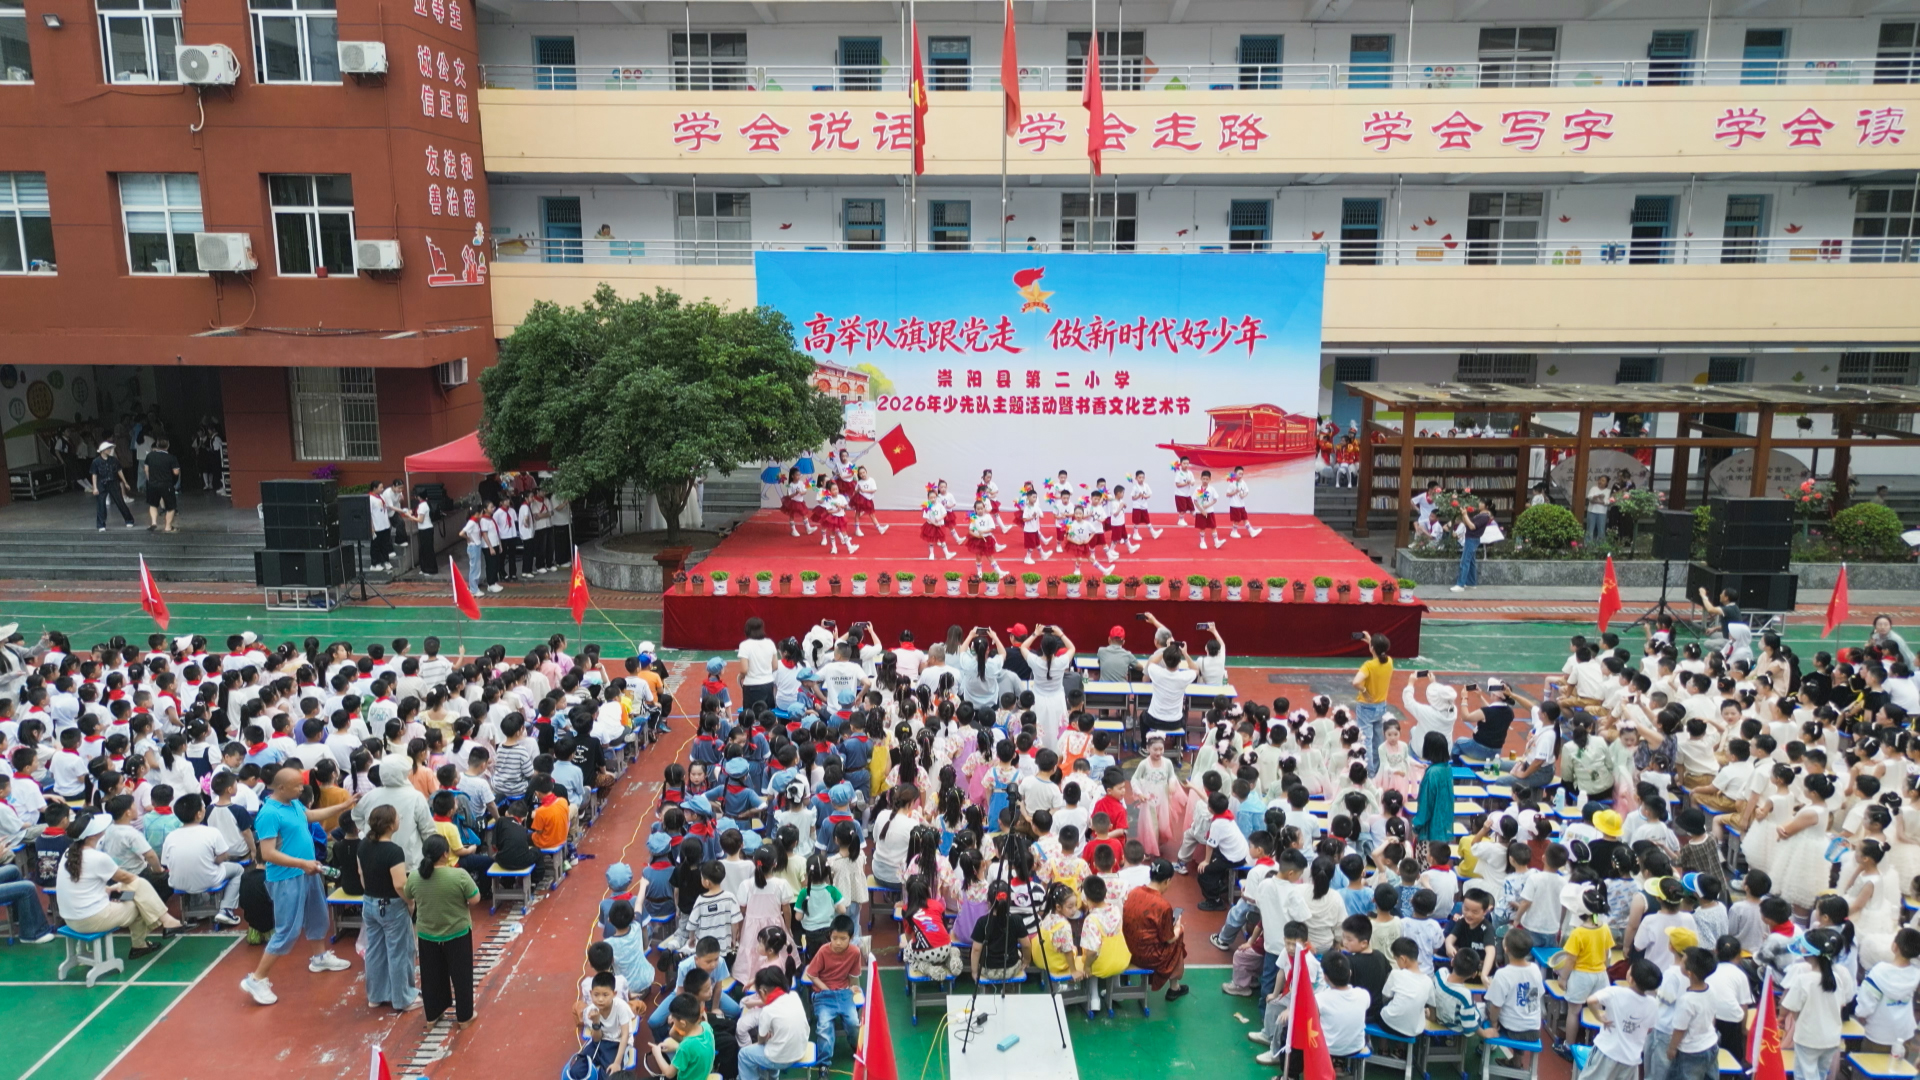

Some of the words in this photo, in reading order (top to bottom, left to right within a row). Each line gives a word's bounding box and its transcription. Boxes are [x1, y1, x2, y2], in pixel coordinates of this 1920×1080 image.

[449, 1, 462, 31] 主
[418, 45, 434, 117] 诚信
[437, 52, 452, 118] 公正
[454, 58, 468, 123] 文明
[672, 111, 911, 153] 学会说话
[1017, 111, 1270, 153] 学会走路
[1362, 109, 1615, 153] 学会写字
[1713, 107, 1907, 149] 学会读
[426, 145, 441, 215] 友善
[444, 149, 459, 217] 法治
[461, 153, 475, 218] 和谐
[803, 312, 1025, 355] 高举队旗跟党走
[1046, 314, 1268, 358] 做新时代好少年
[876, 395, 1191, 416] 2026年少先队主题活动暨书香文化艺术节
[937, 369, 1130, 389] 崇阳县第二小学
